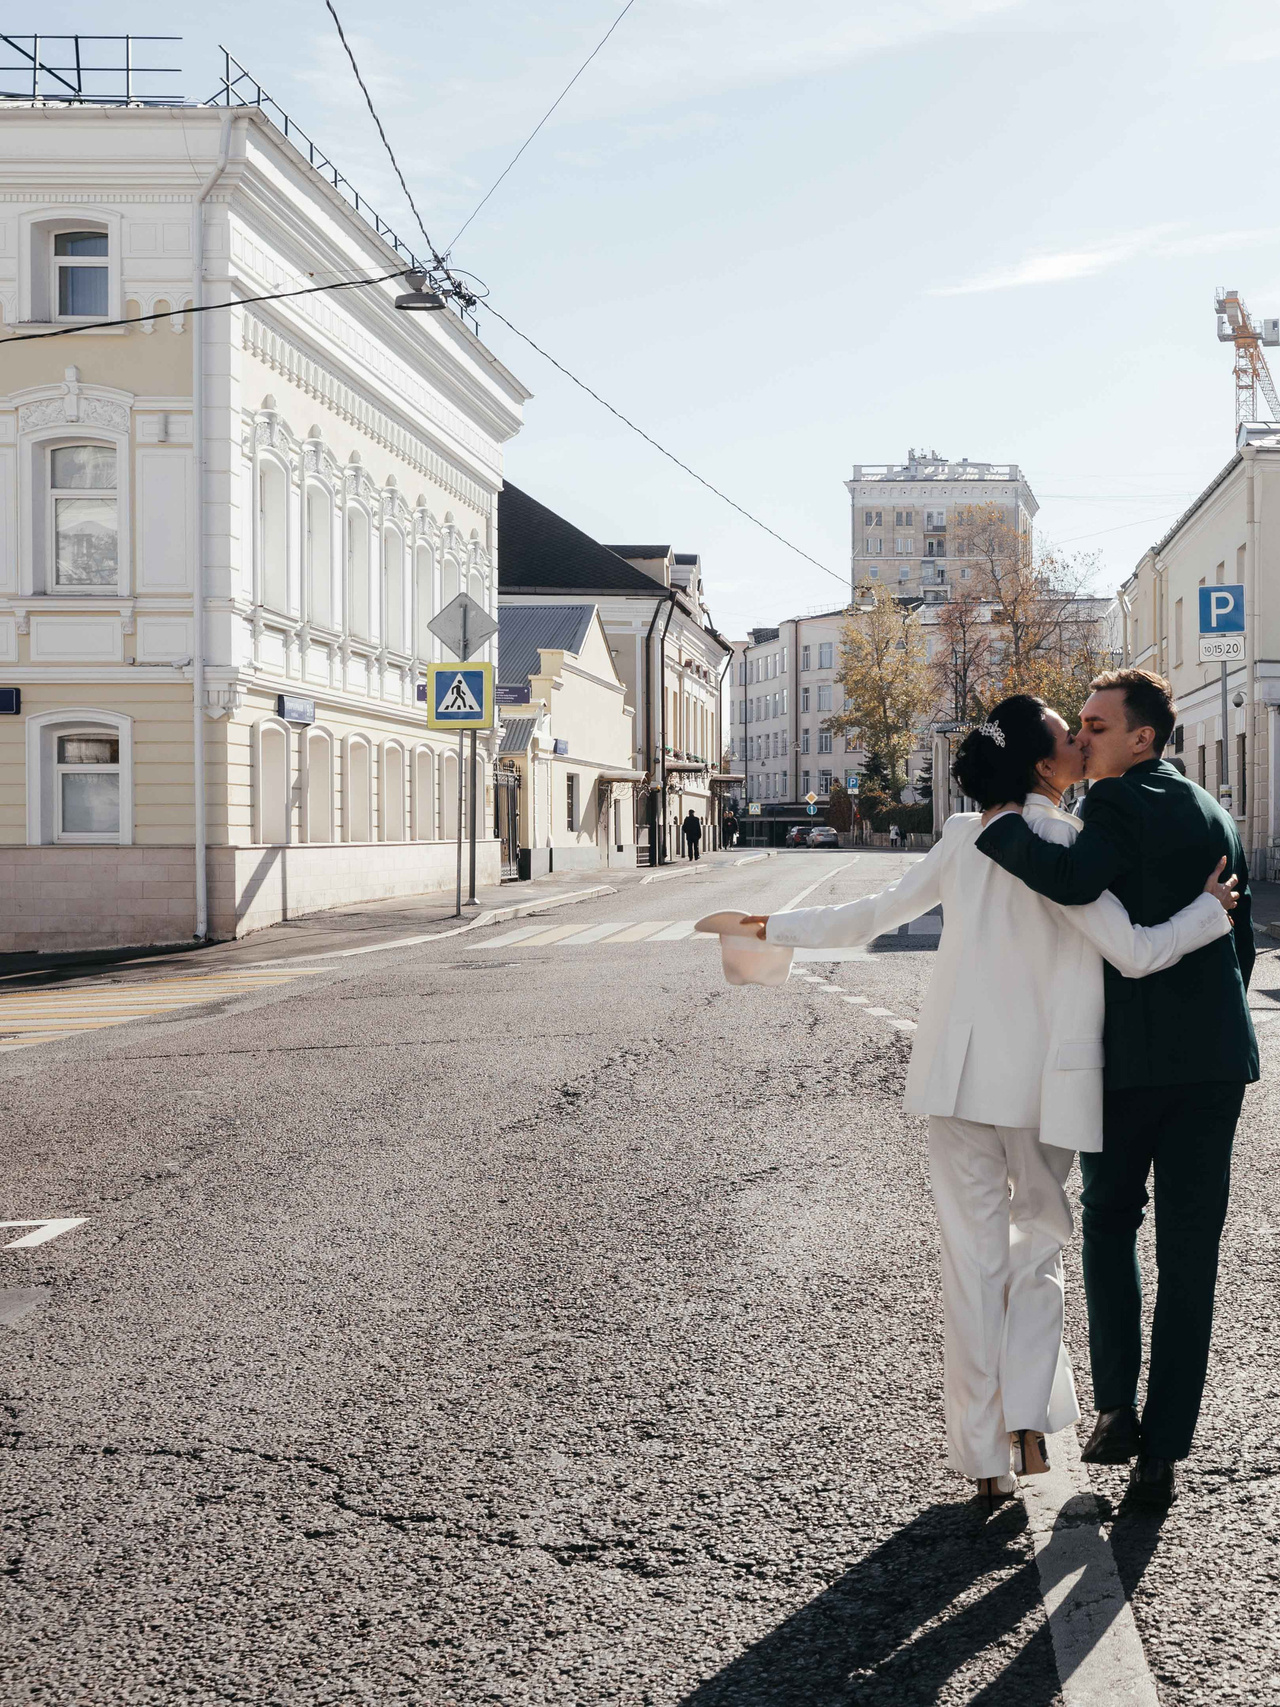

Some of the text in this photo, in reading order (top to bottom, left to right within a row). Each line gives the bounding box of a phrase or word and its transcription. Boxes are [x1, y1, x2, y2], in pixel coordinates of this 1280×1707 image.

[1211, 592, 1235, 627] P
[1214, 645, 1223, 653] 15
[1226, 643, 1239, 653] 20
